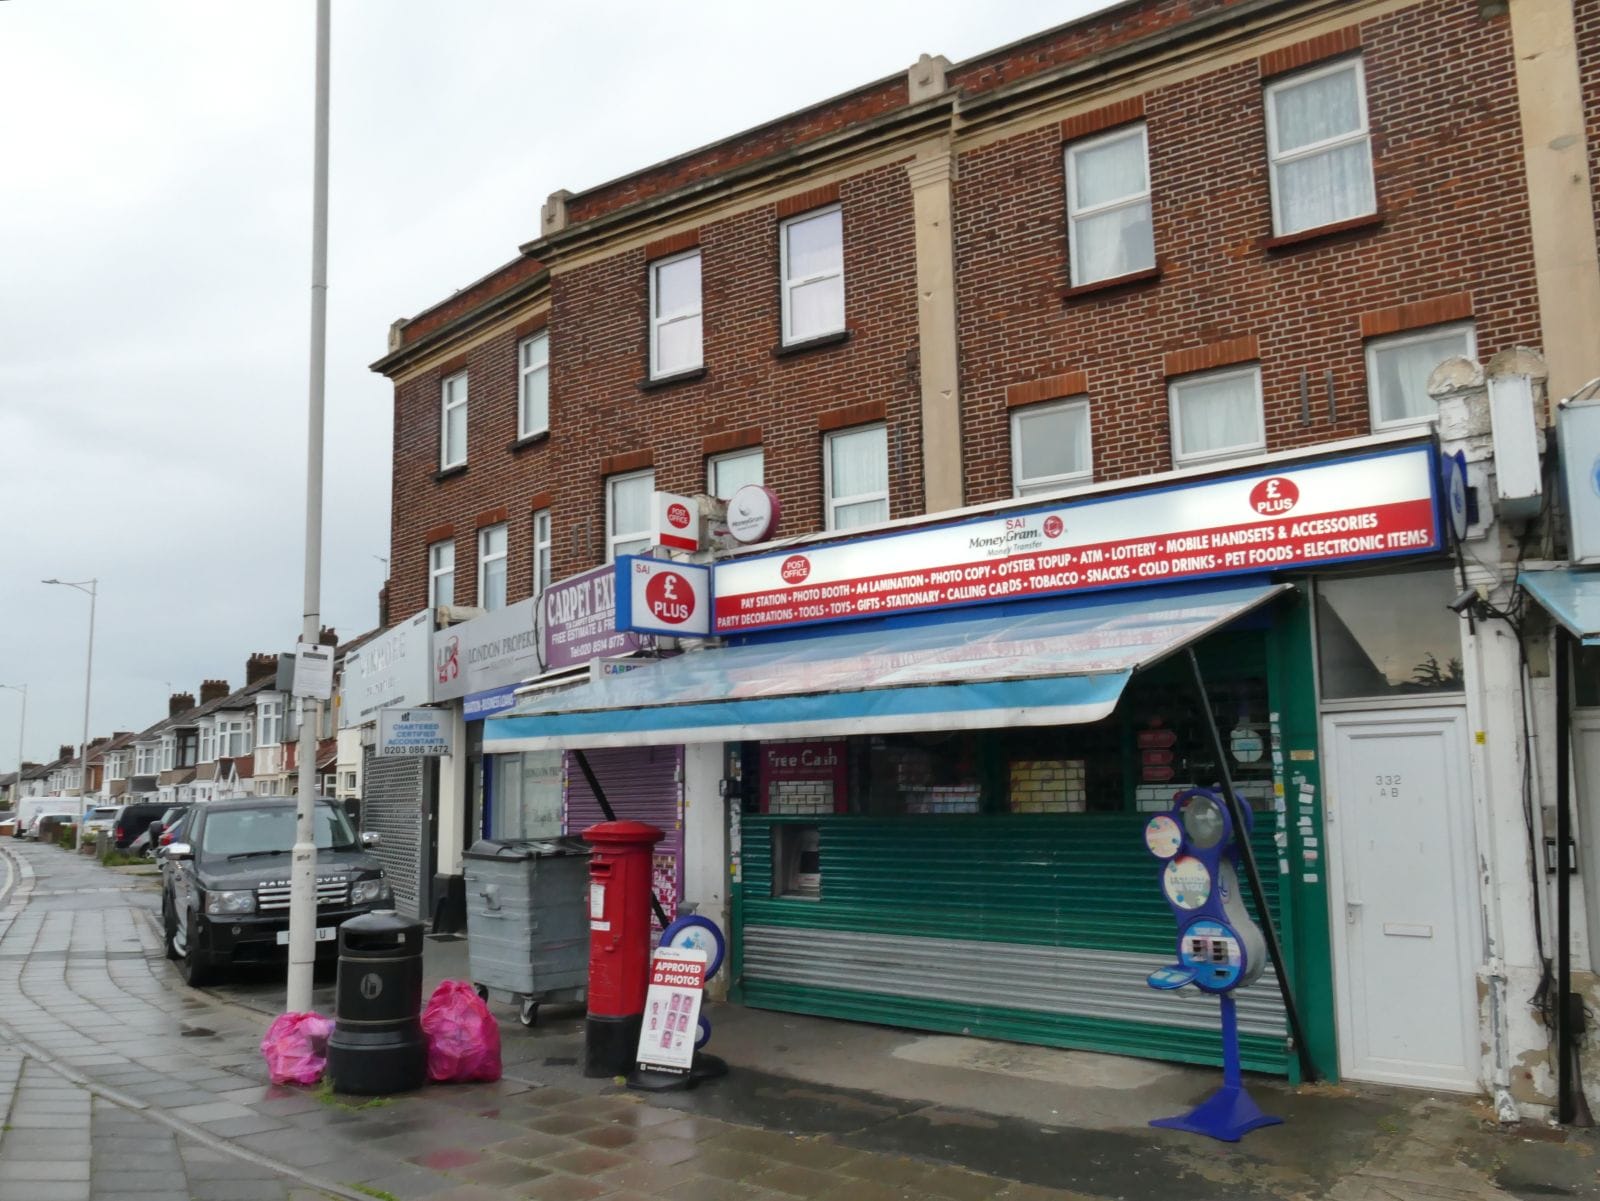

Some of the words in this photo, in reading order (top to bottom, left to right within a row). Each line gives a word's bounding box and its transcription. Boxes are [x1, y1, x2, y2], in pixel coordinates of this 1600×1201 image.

[1265, 479, 1281, 499] £
[672, 508, 686, 517] POST
[1257, 497, 1293, 513] PLUS
[669, 515, 688, 525] OFFICE
[1006, 518, 1025, 529] SAI
[969, 529, 1038, 549] MoneyGram
[987, 546, 1011, 557] Money
[1014, 540, 1042, 550] Transfer
[741, 598, 755, 609] PAY
[756, 595, 787, 607] STATION
[793, 590, 820, 602] PHOTO
[822, 585, 850, 598] BOOTH
[856, 582, 868, 594] A4
[869, 575, 924, 592] LAMINATION
[931, 570, 962, 585] PHOTO
[965, 565, 990, 580] COPY
[998, 559, 1035, 576] OYSTER
[1038, 553, 1071, 569] TOPUP
[1080, 550, 1103, 564] ATM
[1111, 542, 1157, 560] LOTTERY
[1166, 535, 1209, 553] MOBILE
[1212, 526, 1275, 547] HANDSETS
[1278, 526, 1287, 539] &
[1291, 513, 1378, 537] ACCESSORIES
[787, 560, 805, 570] POST
[717, 616, 739, 628] PARTY
[741, 609, 793, 625] DECORATIONS
[799, 605, 824, 617] TOOLS
[830, 601, 851, 614] TOYS
[857, 598, 880, 611] GIFTS
[886, 590, 940, 608] STATIONARY
[947, 585, 986, 601] CALLING
[988, 579, 1022, 596] CARDS
[1029, 572, 1079, 589] TOBACCO
[1087, 565, 1130, 582] SNACKS
[1138, 561, 1169, 576] COLD
[1172, 555, 1216, 573] DRINKS
[1225, 552, 1247, 566] PET
[1249, 545, 1294, 563] FOODS
[1304, 534, 1384, 557] ELECTRONIC
[1388, 529, 1428, 548] ITEMS
[783, 568, 807, 579] OFFICE
[664, 575, 677, 600] £
[547, 580, 591, 627] CARPET
[654, 601, 688, 619] PLUS
[552, 632, 567, 645] FREE
[567, 623, 596, 641] ESTIMATE
[468, 640, 500, 664] LONDON
[392, 723, 440, 731] CHARTERED
[384, 746, 406, 754] 0203
[427, 744, 449, 753] 7472
[768, 751, 798, 767] Free
[801, 747, 838, 766] Cash
[1375, 774, 1401, 786] 332
[655, 961, 702, 974] APPROVED
[653, 973, 663, 983] ID
[664, 974, 700, 986] PHOTOS
